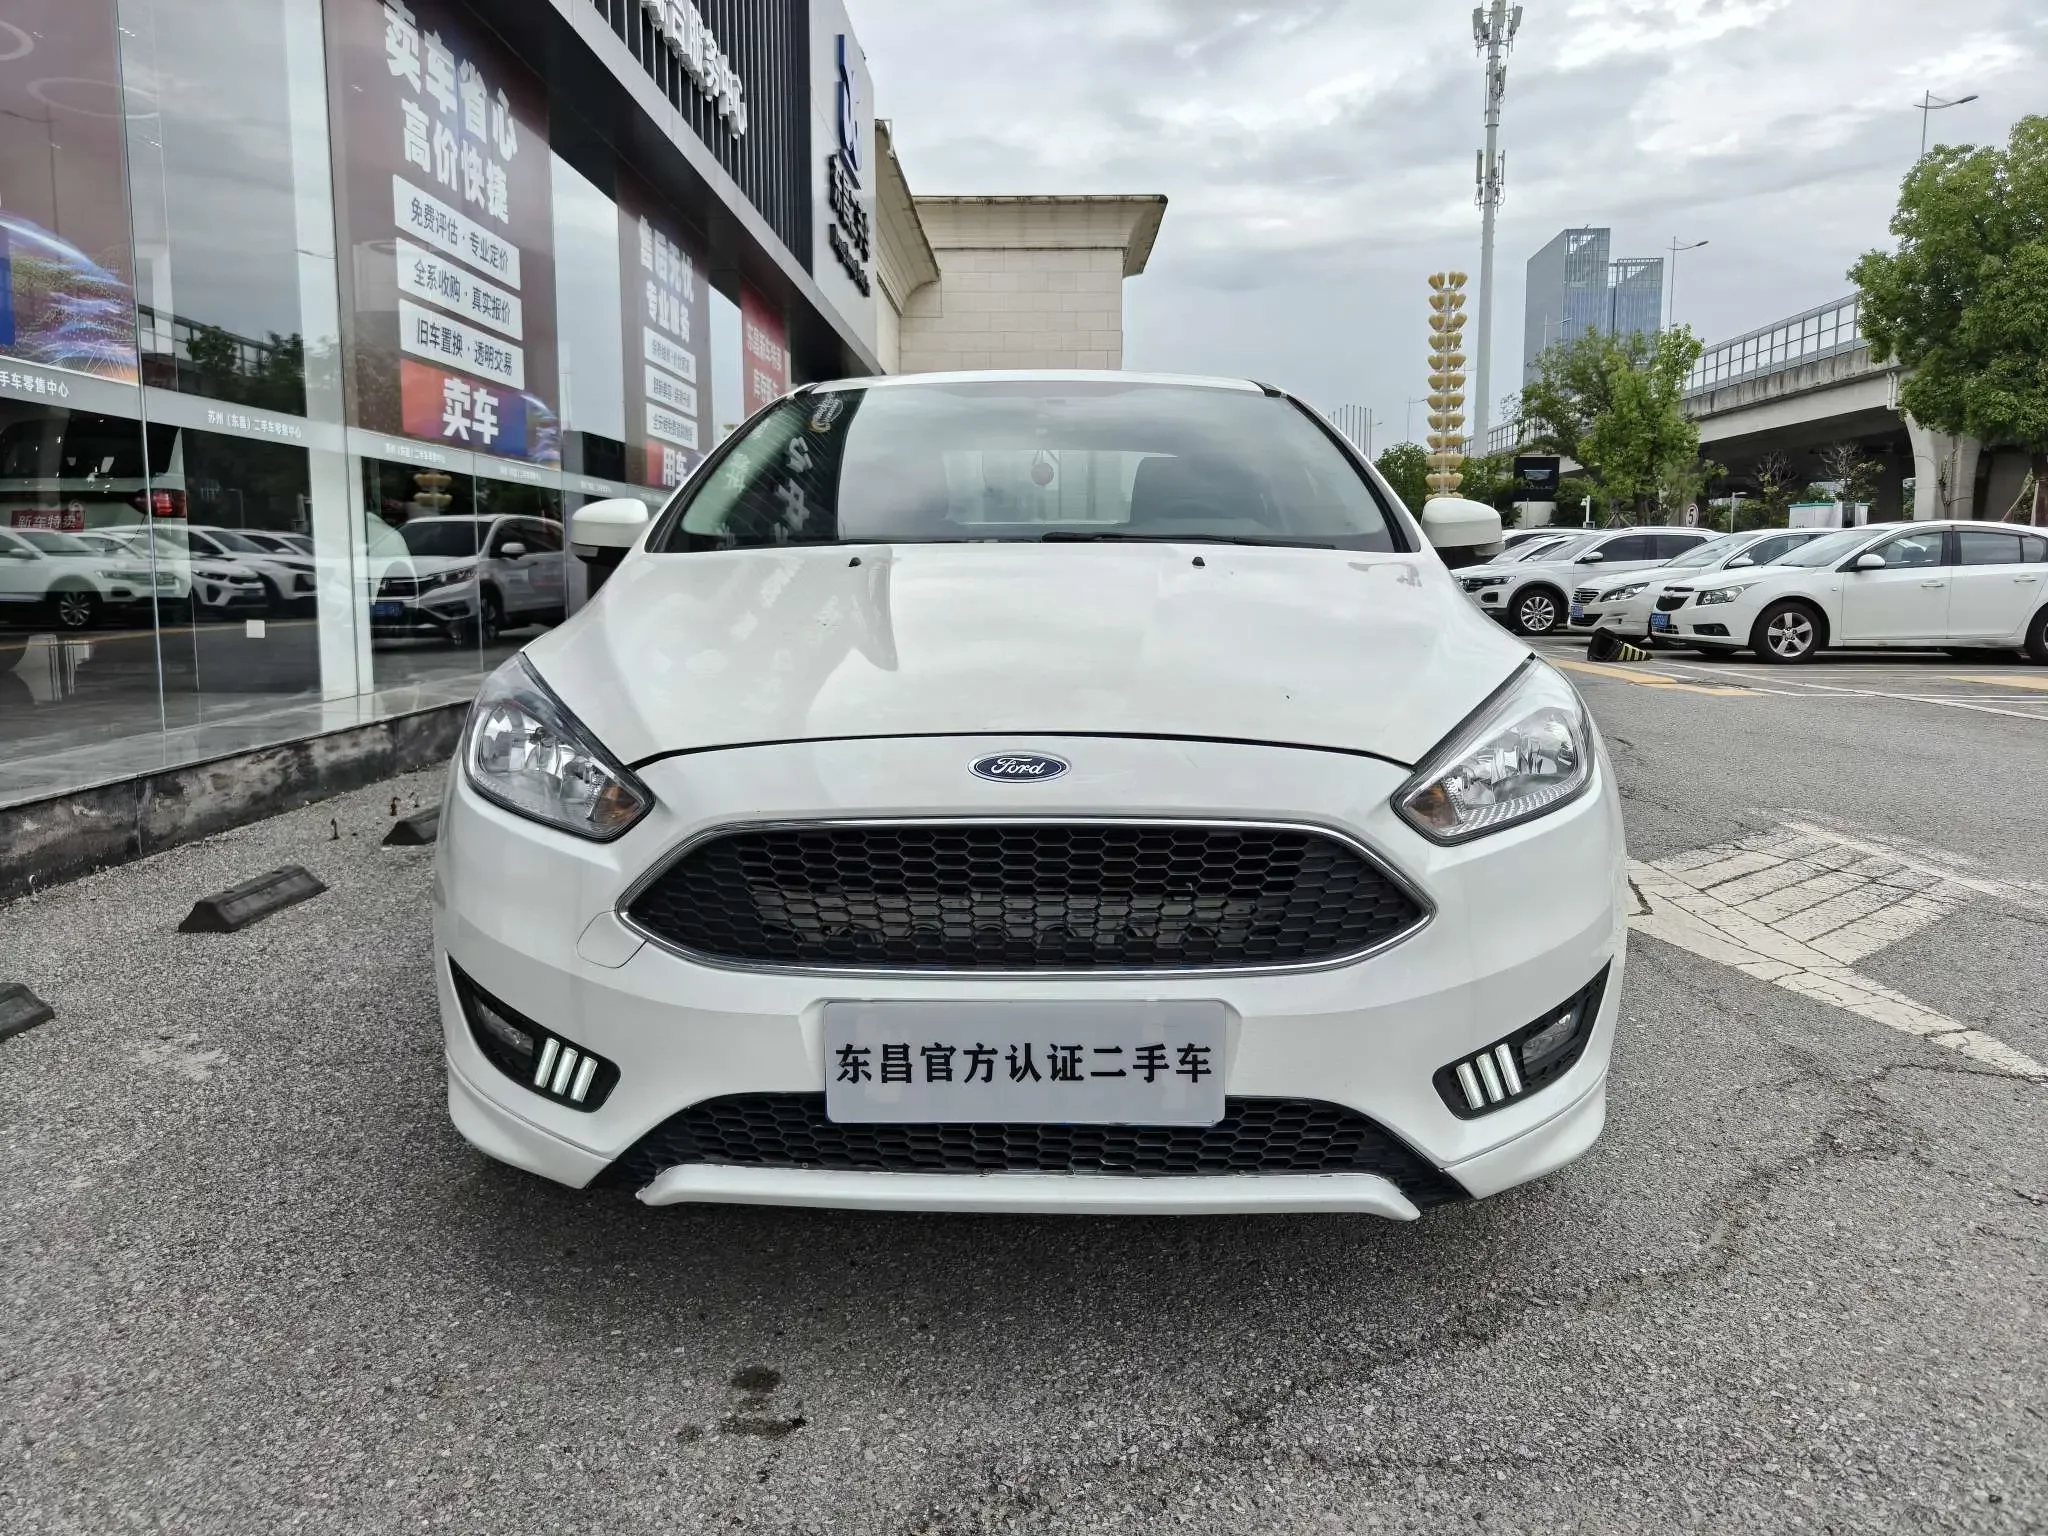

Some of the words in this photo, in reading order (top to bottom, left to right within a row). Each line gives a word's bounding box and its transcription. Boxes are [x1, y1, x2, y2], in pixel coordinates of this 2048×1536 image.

[384, 0, 517, 162] 卖车省心
[402, 98, 508, 224] 高价快捷
[443, 377, 499, 444] 卖车
[663, 447, 687, 488] 用车
[991, 757, 1046, 775] Ford
[835, 1042, 1213, 1084] 东昌官方认证二手车
